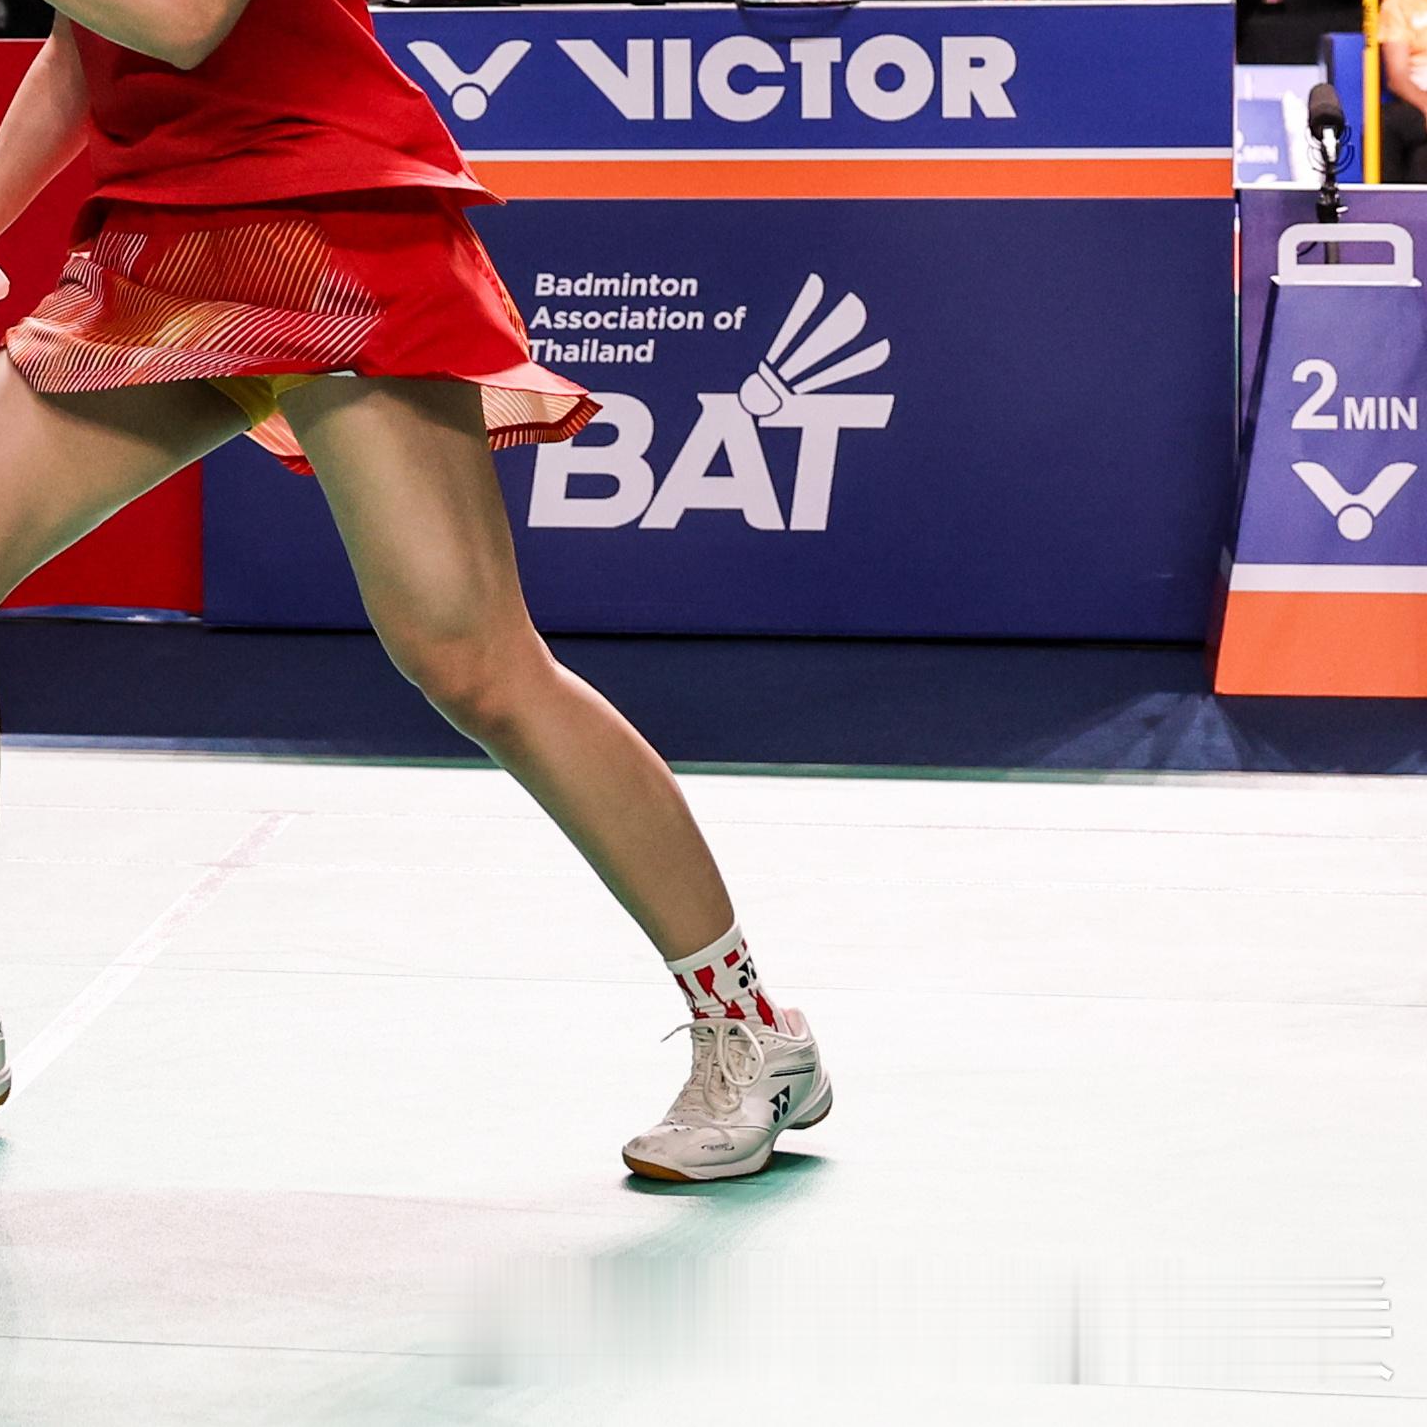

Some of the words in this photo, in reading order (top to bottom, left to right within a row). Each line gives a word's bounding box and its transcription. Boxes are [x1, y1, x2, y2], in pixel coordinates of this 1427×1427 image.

[555, 34, 1019, 122] VICTOR
[534, 272, 698, 297] Badminton
[529, 305, 704, 331] Association
[713, 306, 747, 331] of
[528, 339, 655, 364] Thailand
[1291, 358, 1339, 430] 2
[1343, 396, 1418, 430] MIN
[527, 391, 895, 532] BAT
